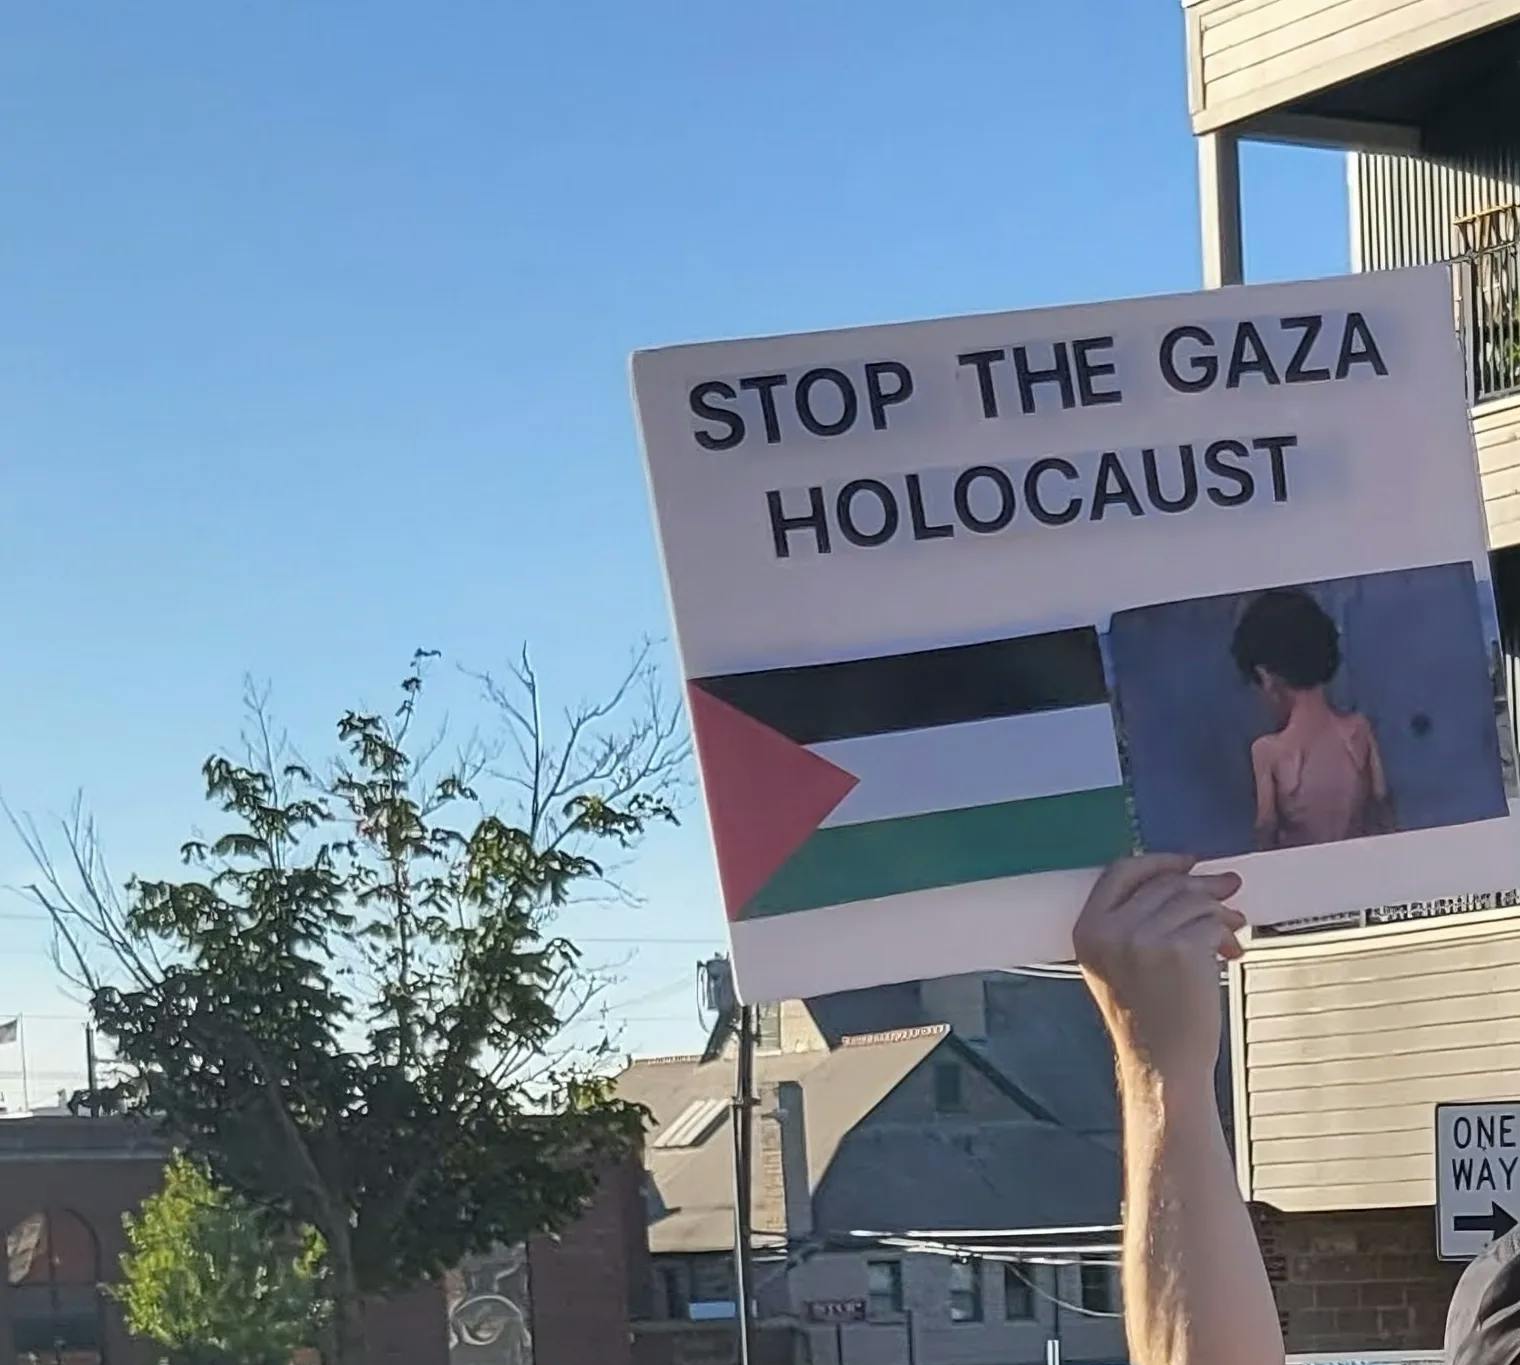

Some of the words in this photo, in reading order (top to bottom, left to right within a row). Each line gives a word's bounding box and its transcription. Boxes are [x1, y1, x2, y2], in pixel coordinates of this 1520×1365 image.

[689, 361, 913, 450] STOP
[959, 336, 1123, 419] THE
[1159, 312, 1389, 394] GAZA
[766, 436, 1299, 558] HOLOCAUST
[1453, 1115, 1517, 1148] ONE
[1452, 1156, 1518, 1191] WAY
